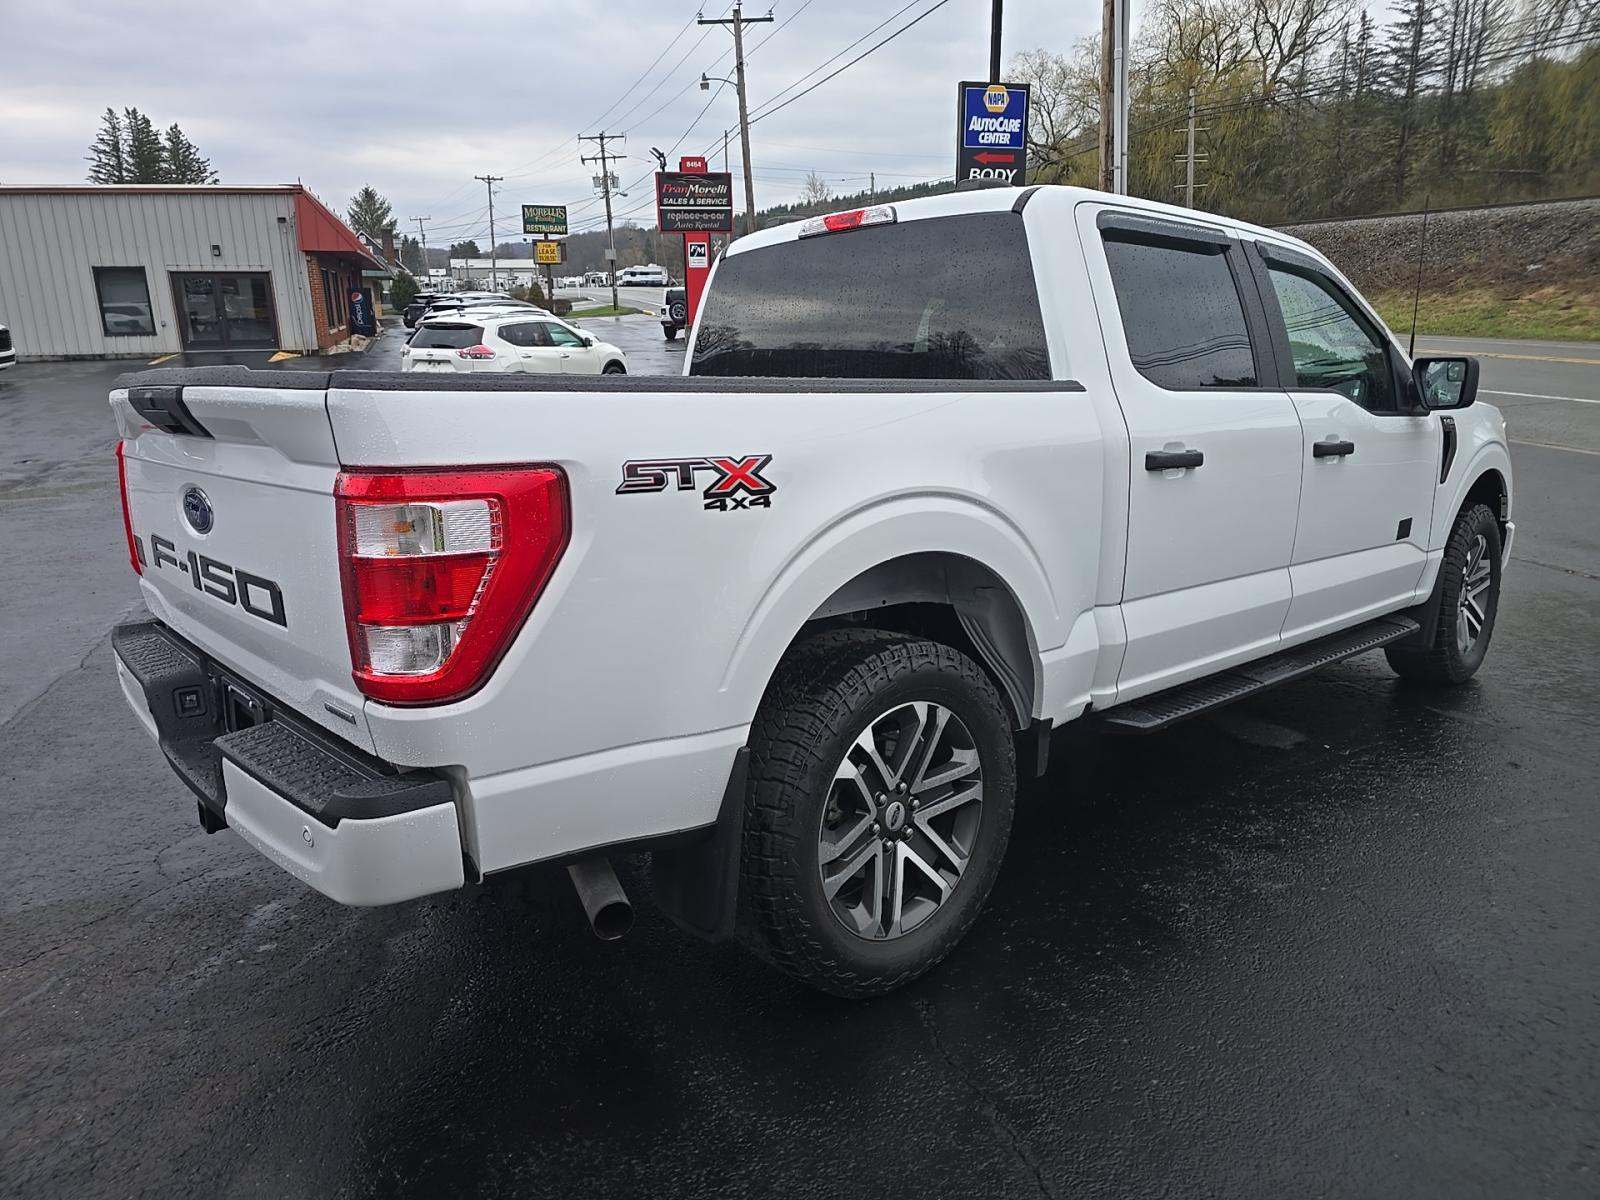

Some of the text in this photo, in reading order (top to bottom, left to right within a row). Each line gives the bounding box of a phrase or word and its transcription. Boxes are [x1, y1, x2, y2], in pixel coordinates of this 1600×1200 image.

[988, 92, 1005, 106] NAPA
[969, 116, 1021, 132] AUTOCARE
[978, 132, 1011, 144] CENTER
[969, 168, 1017, 183] BODY
[667, 211, 725, 221] replace-a-car
[526, 224, 567, 232] RESTAURANT
[616, 454, 777, 499] STX
[151, 534, 288, 628] F-150
